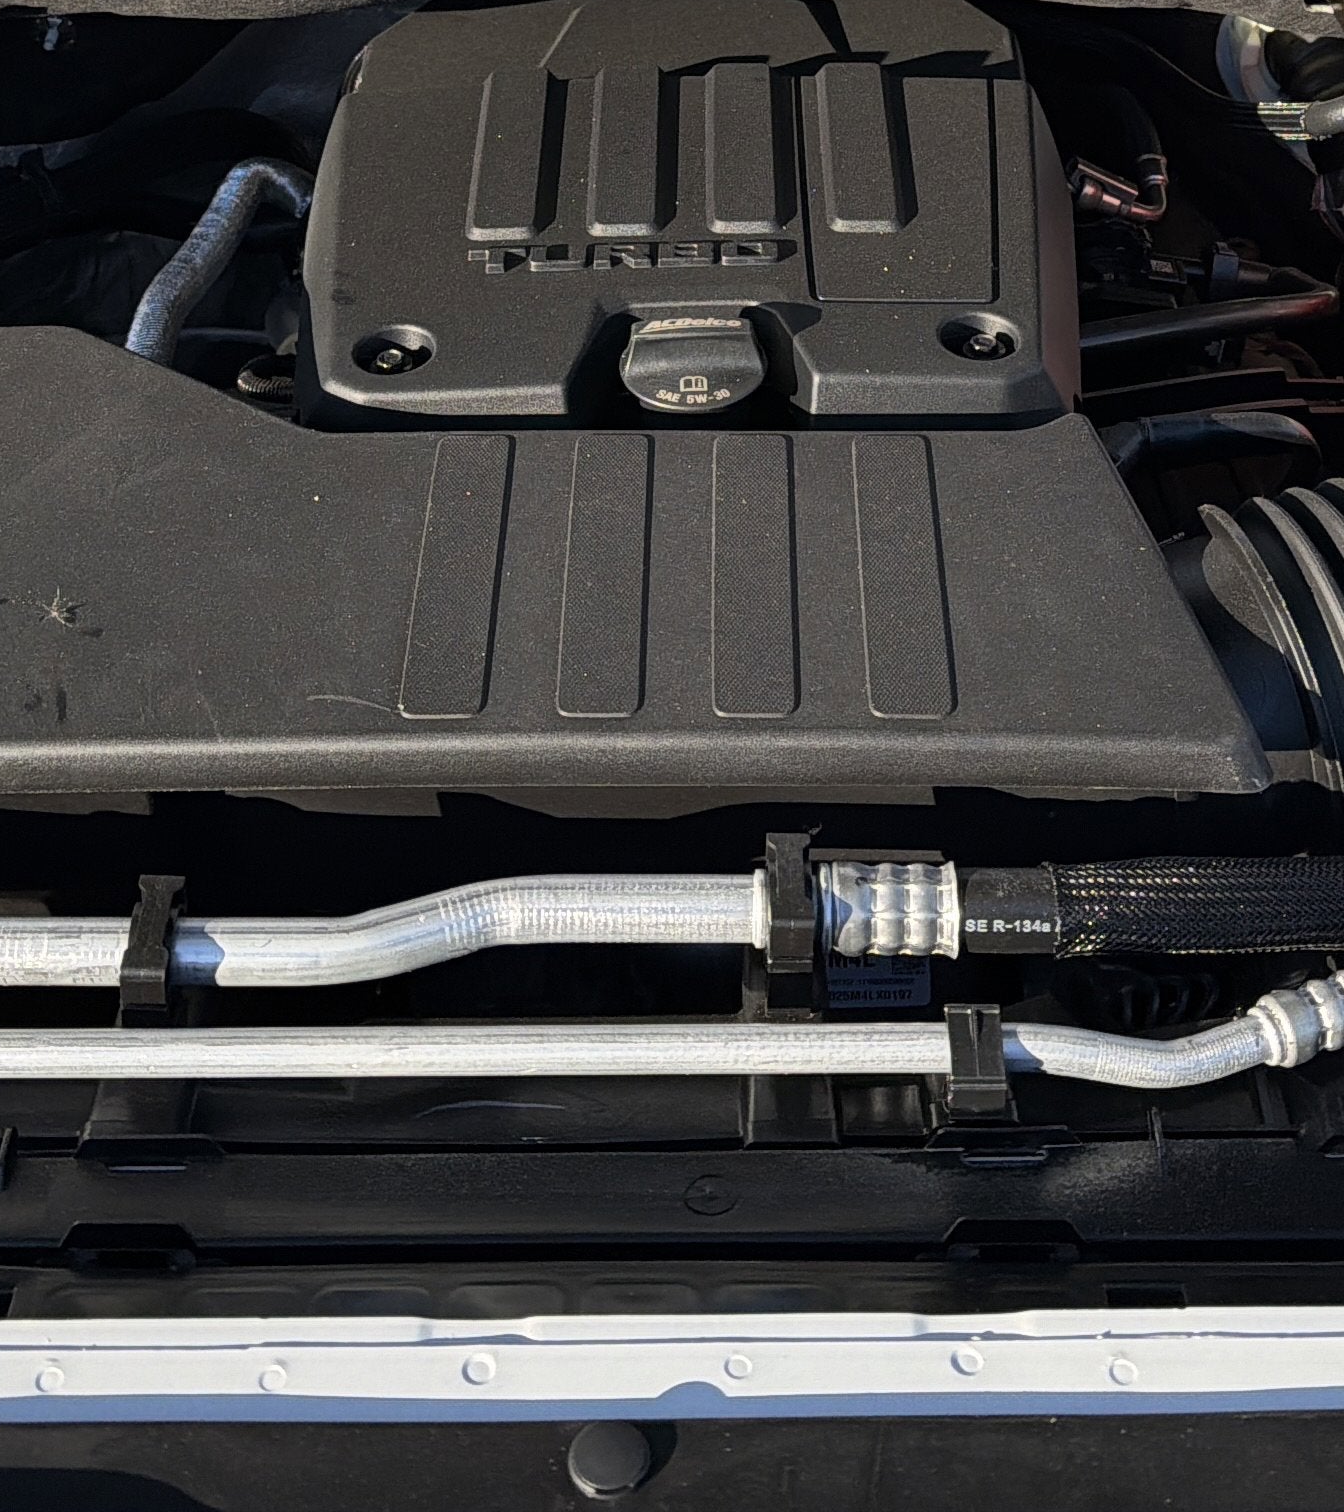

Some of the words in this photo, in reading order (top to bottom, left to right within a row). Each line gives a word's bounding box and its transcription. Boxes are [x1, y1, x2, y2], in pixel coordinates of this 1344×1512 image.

[468, 240, 779, 274] TURBO
[640, 317, 743, 333] ACDelco
[656, 389, 681, 403] SAE
[686, 388, 731, 405] 5W-30
[992, 919, 1051, 933] R-134a
